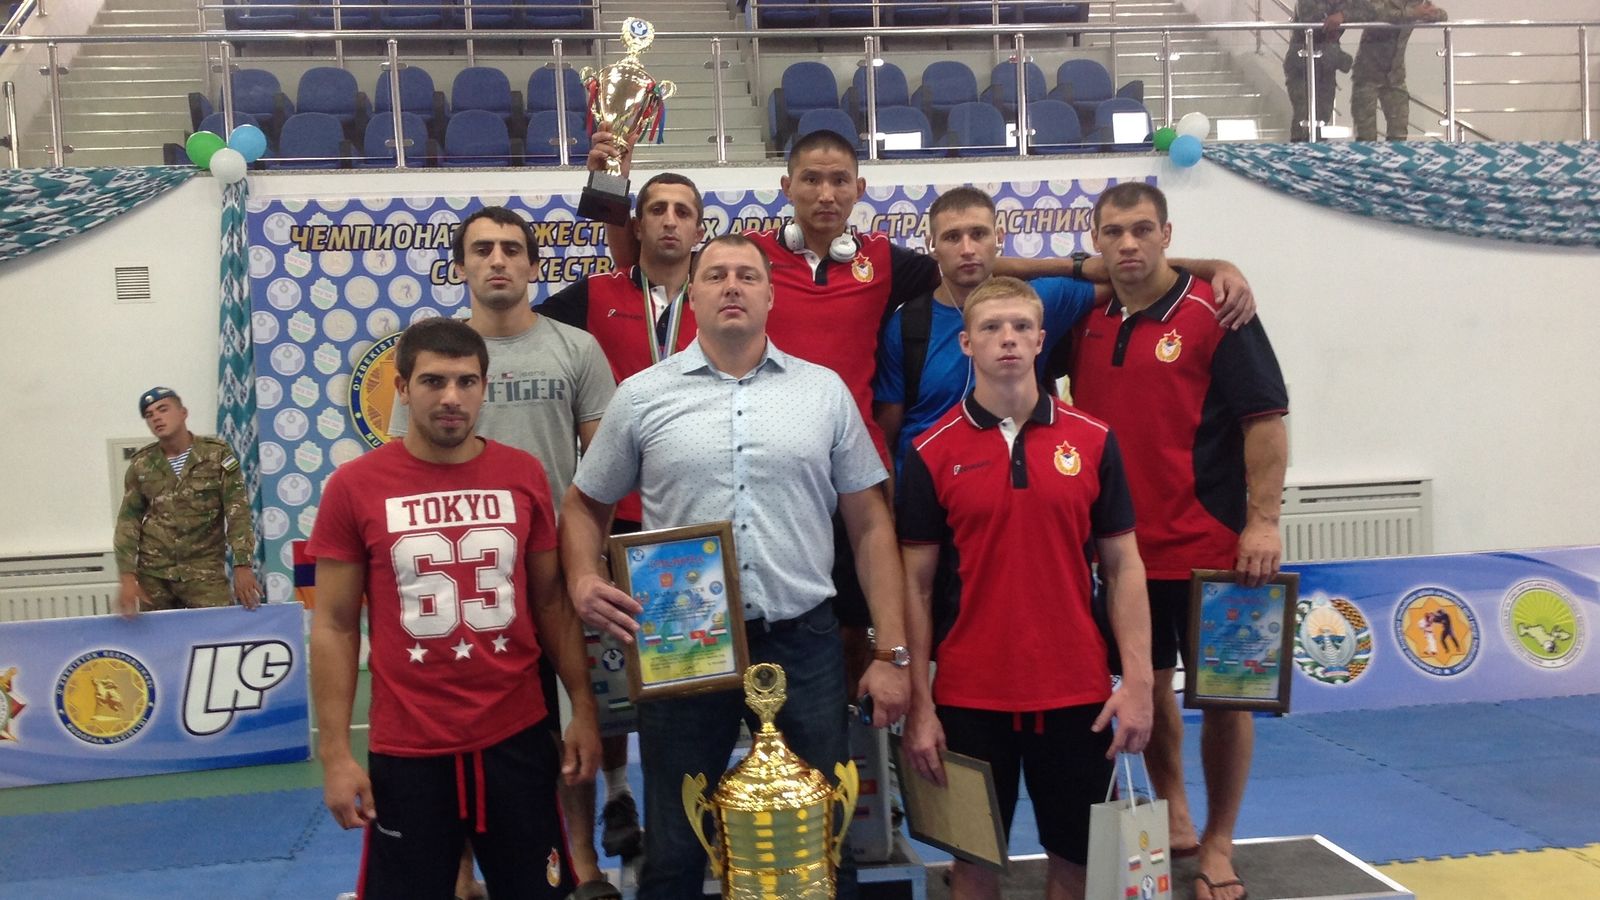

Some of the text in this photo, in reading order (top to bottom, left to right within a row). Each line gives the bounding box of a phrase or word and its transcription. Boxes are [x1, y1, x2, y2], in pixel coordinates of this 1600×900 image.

[871, 212, 931, 240] СТРА
[996, 207, 1097, 234] АСТНИК
[402, 494, 501, 526] TOKYO
[391, 526, 518, 639] 63
